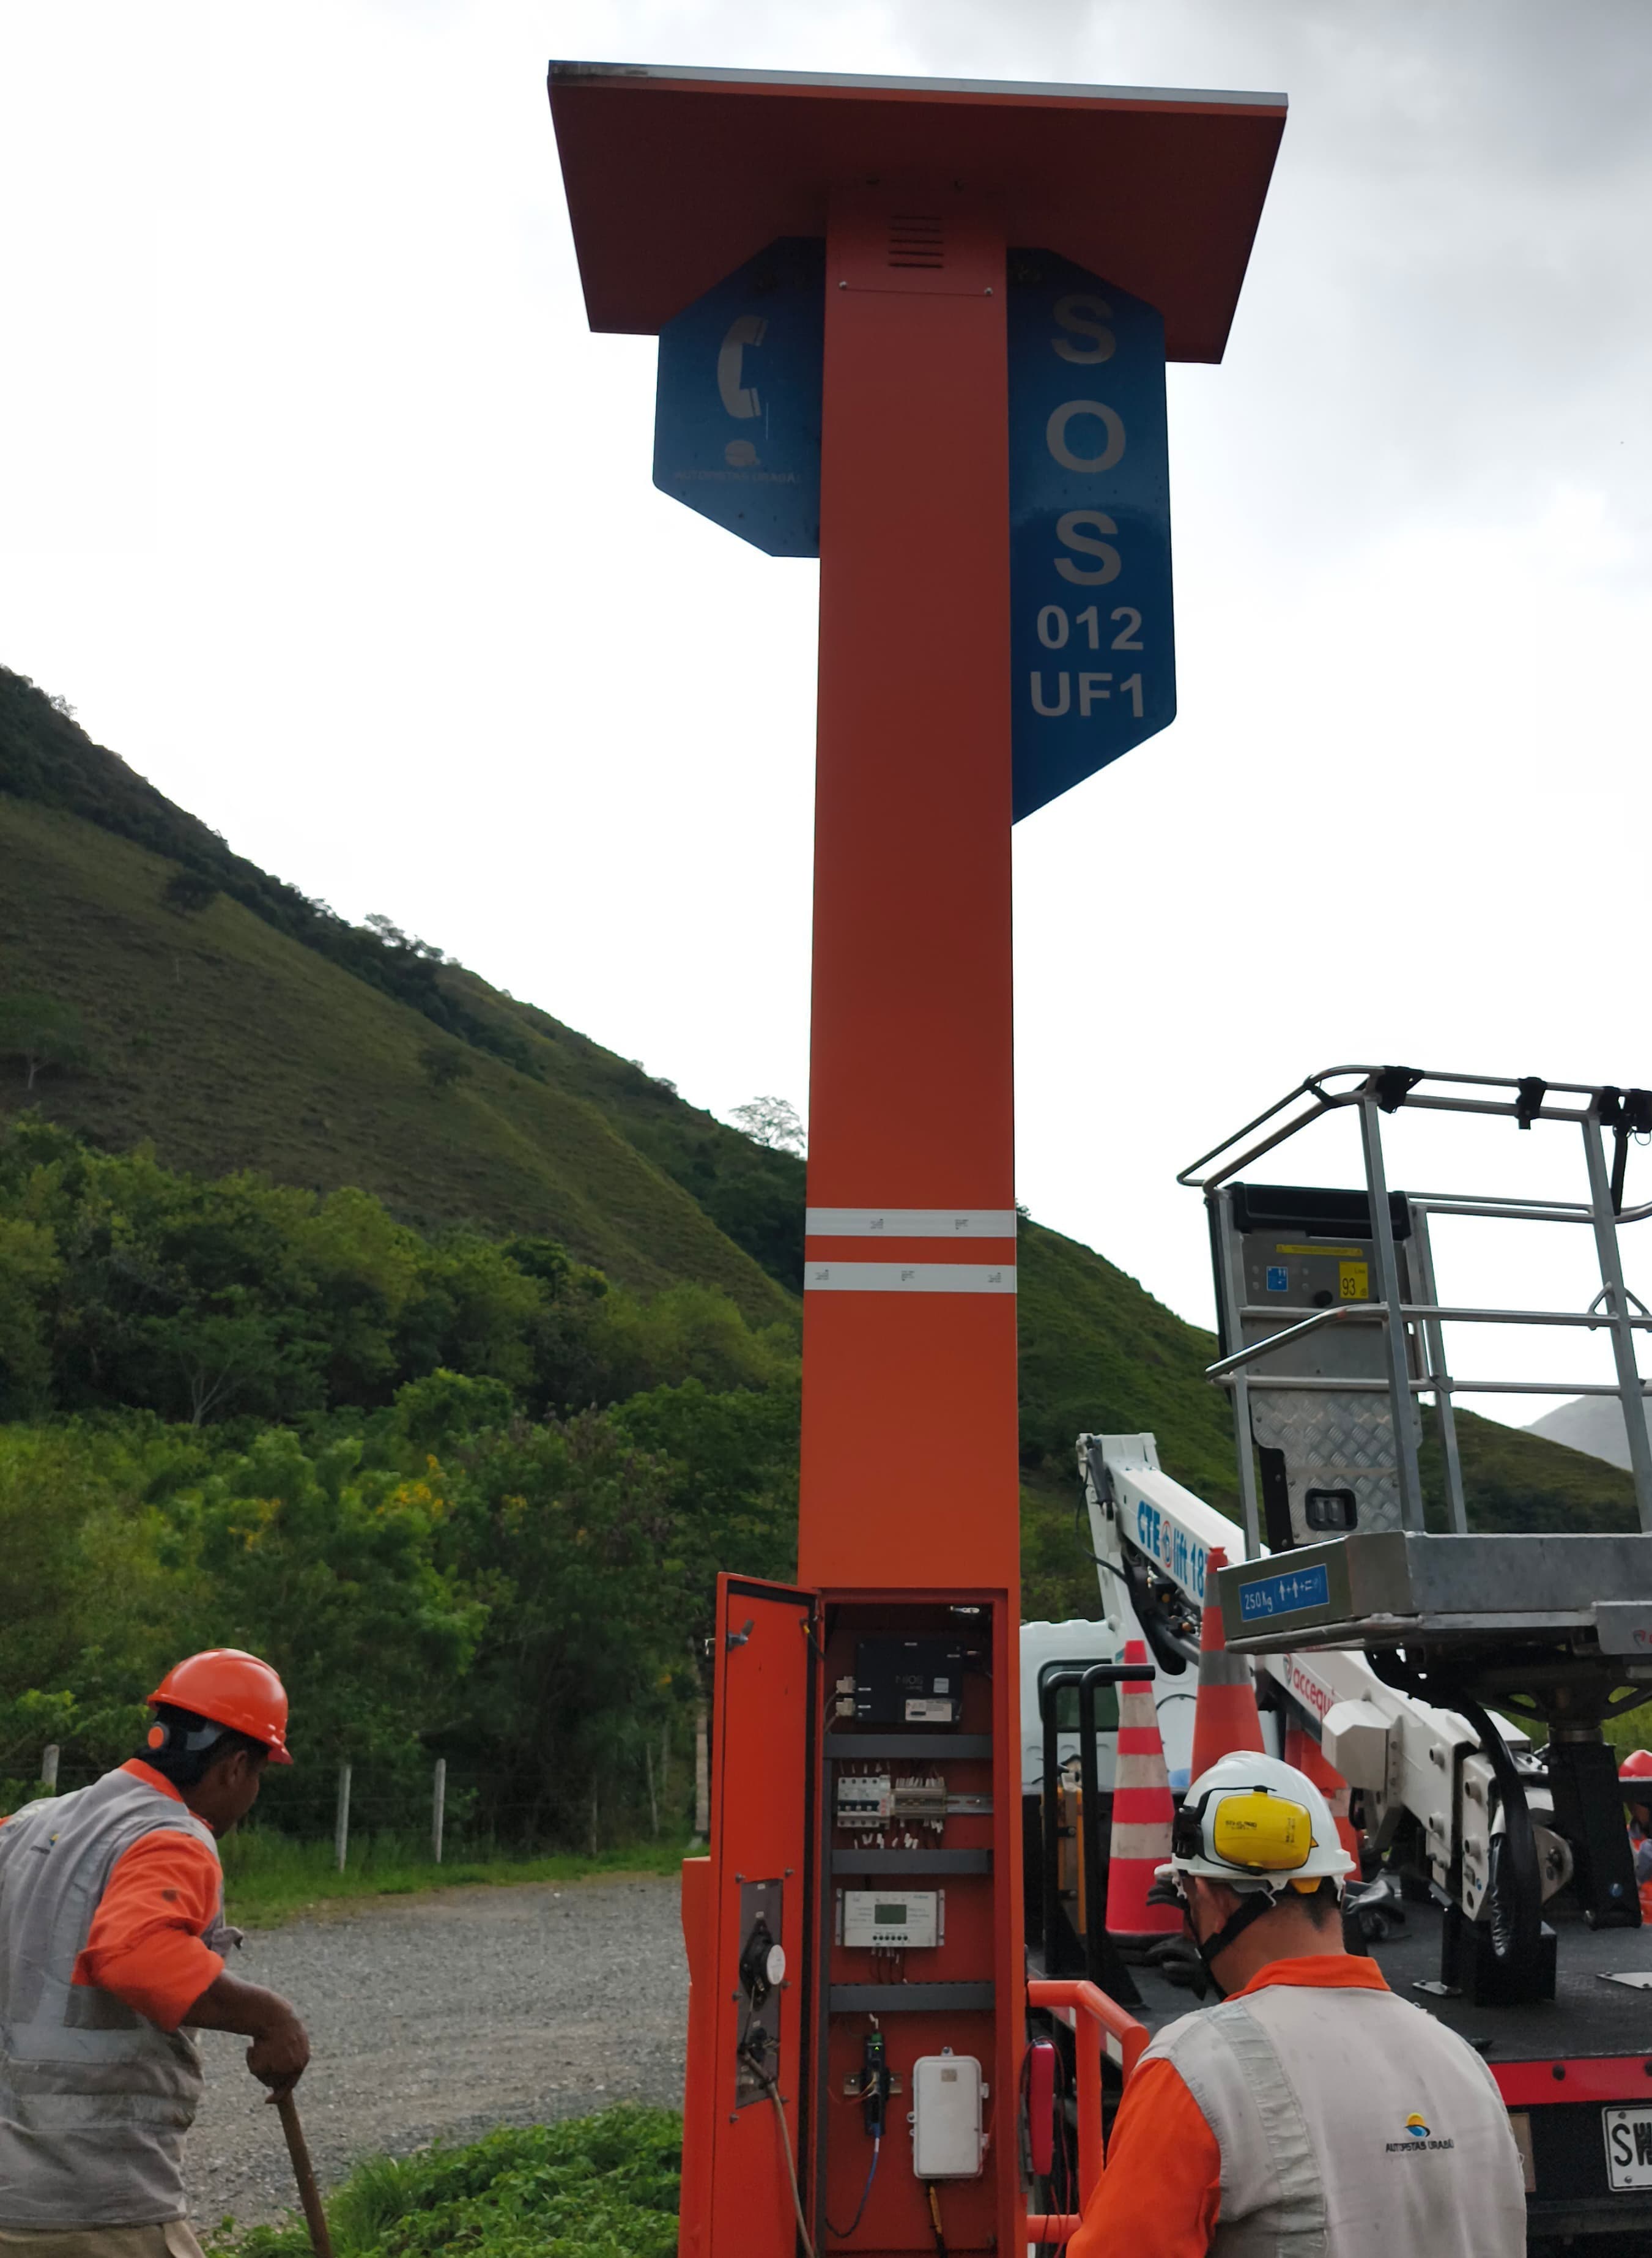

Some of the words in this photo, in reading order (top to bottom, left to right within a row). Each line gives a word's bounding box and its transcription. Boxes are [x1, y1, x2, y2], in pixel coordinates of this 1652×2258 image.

[1037, 604, 1144, 651] 012
[1029, 670, 1144, 718] UF1
[1342, 1277, 1356, 1296] 93
[1137, 1500, 1160, 1558] CTE
[1174, 1528, 1188, 1585] lift
[1191, 1542, 1209, 1598] 18
